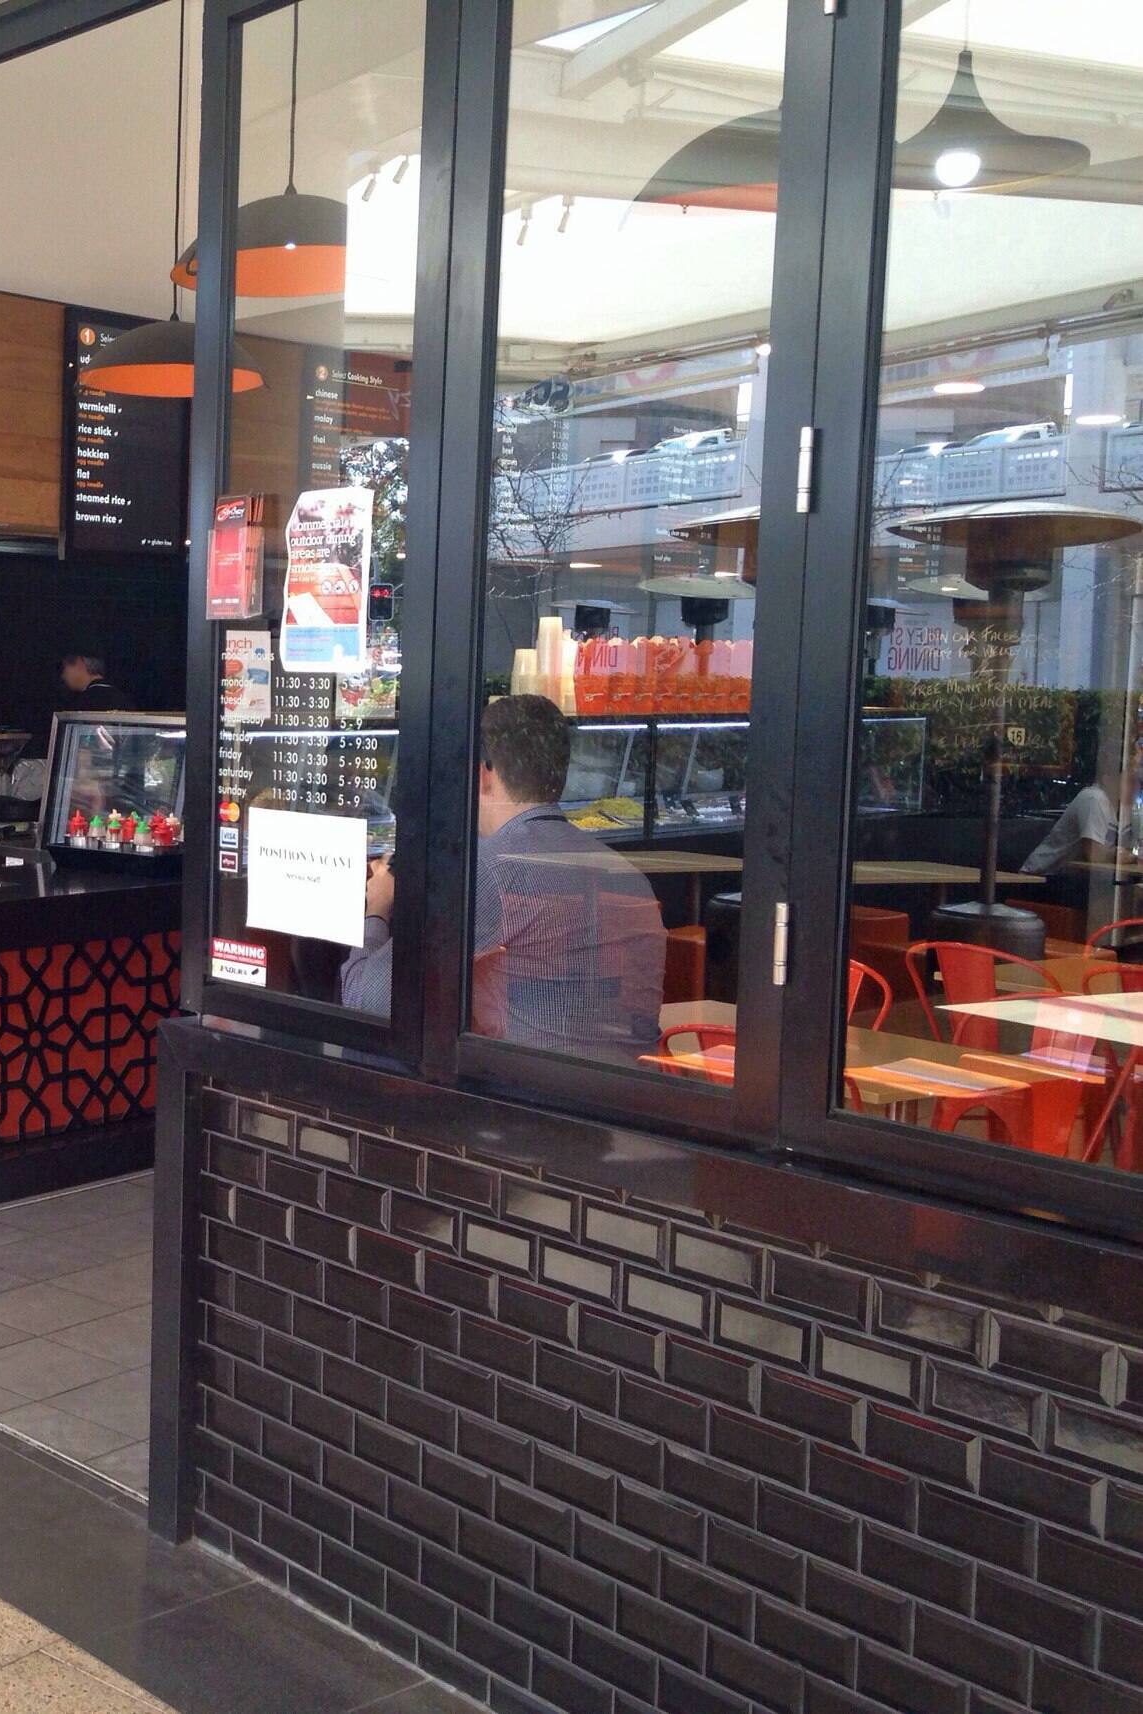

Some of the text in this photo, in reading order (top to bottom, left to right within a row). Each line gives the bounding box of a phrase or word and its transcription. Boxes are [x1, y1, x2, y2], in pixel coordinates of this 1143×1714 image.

[315, 388, 338, 400] chinese
[78, 402, 116, 414] vermicelli
[78, 423, 112, 437] rice stick
[77, 446, 110, 460] hokkien
[76, 468, 90, 480] flat
[76, 492, 126, 506] steamed rice
[75, 510, 117, 524] brown rice
[275, 676, 301, 689] 11:30
[309, 677, 330, 690] 3:30
[274, 695, 300, 708] 11:30
[309, 696, 330, 709] 3:30
[274, 714, 300, 727] 11:30
[308, 715, 329, 728] 3:30
[340, 718, 346, 729] 5
[356, 718, 363, 730] 9
[273, 734, 299, 746] 11:30
[307, 735, 329, 748] 3:30
[339, 736, 346, 748] 5
[356, 737, 378, 750] 9:30
[219, 747, 242, 762] friday
[273, 751, 298, 764] 11:30
[307, 754, 328, 767] 3:30
[338, 756, 345, 768] 5
[355, 756, 377, 770] 9:30
[218, 767, 253, 781] saturday
[273, 769, 298, 782] 11:30
[306, 772, 328, 786] 3:30
[338, 775, 345, 787] 5
[355, 776, 377, 790] 9:30
[218, 784, 247, 799] sunday
[272, 787, 297, 801] 11:30
[306, 791, 327, 805] 3:30
[337, 794, 344, 806] 5
[354, 795, 360, 807] 9
[259, 846, 307, 861] POSITION
[213, 940, 265, 960] WARNING
